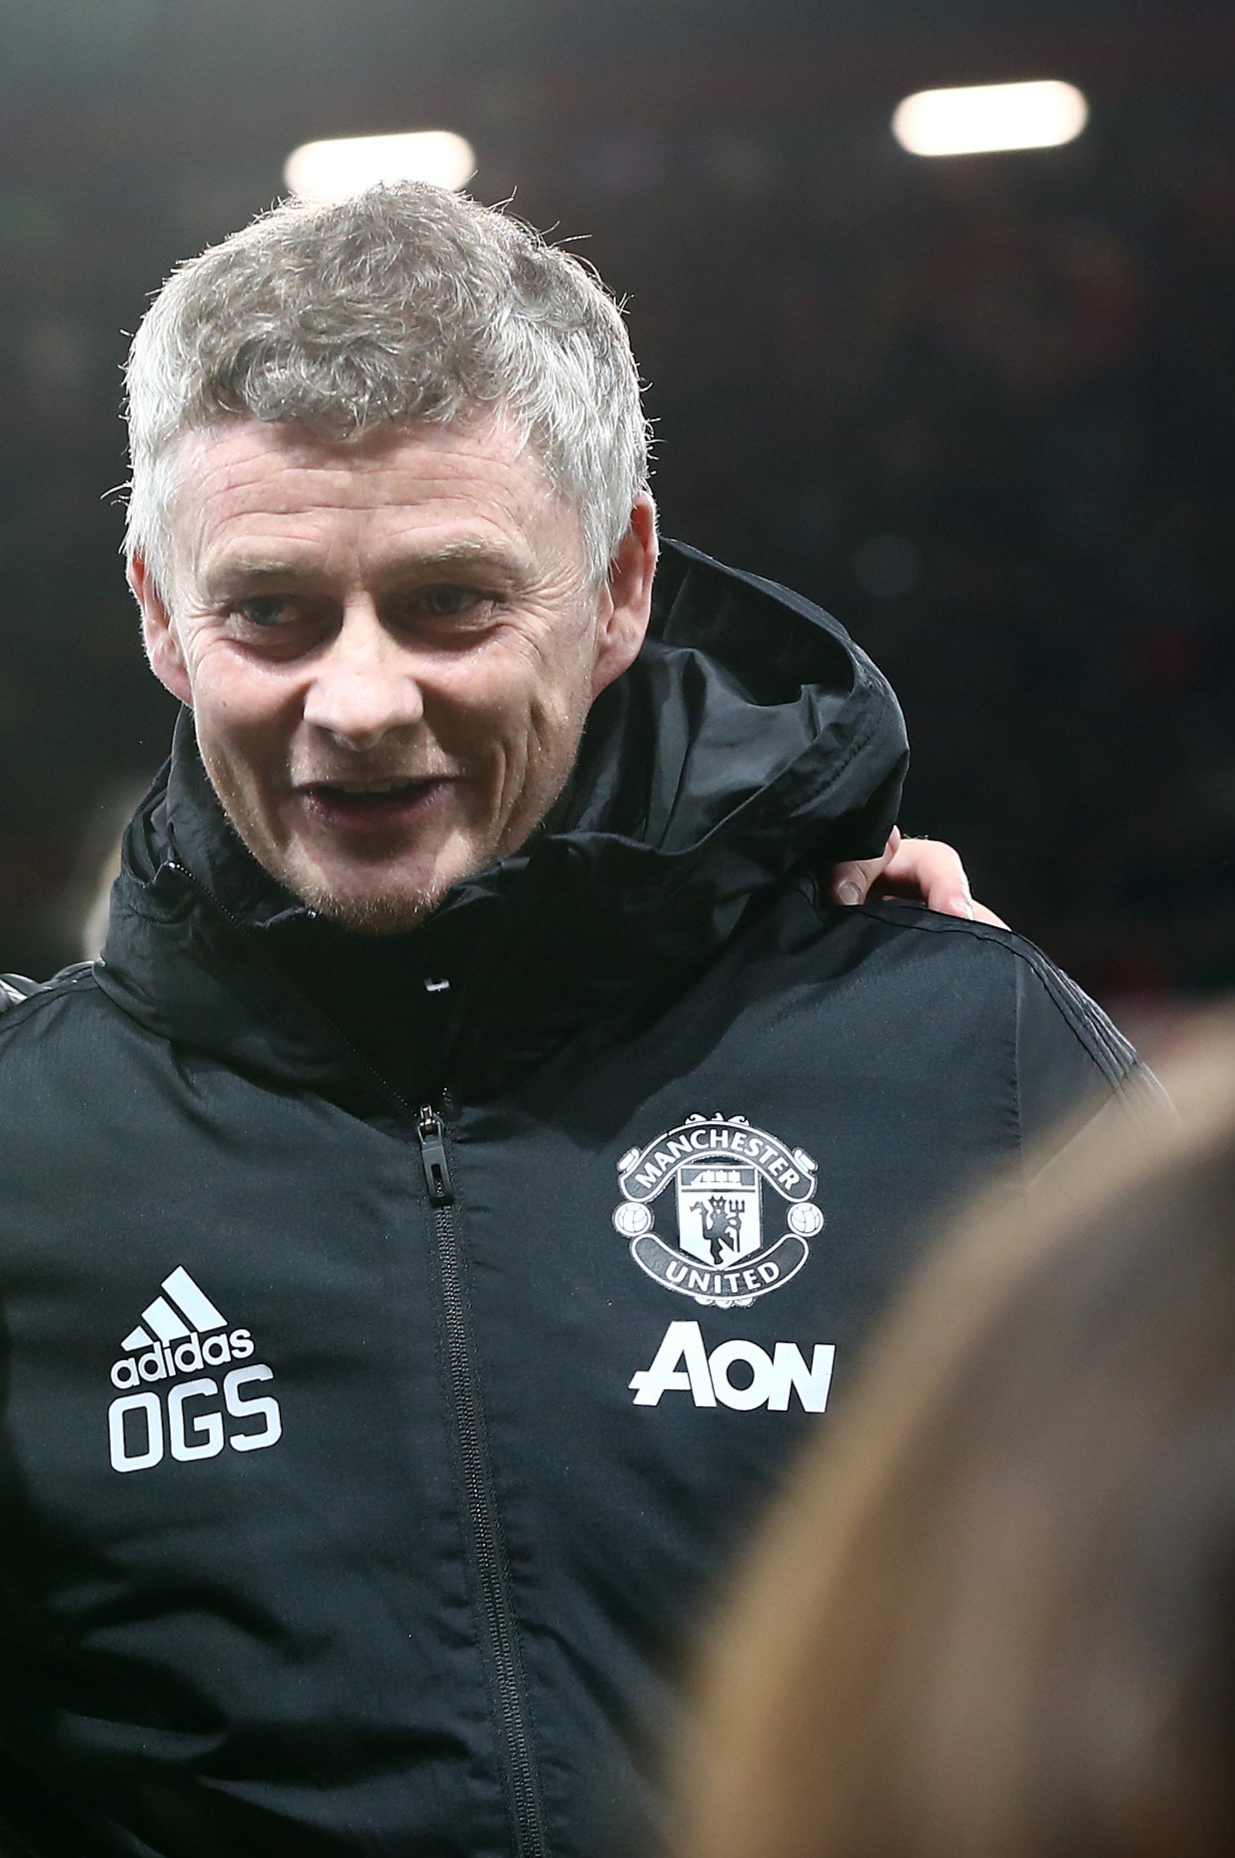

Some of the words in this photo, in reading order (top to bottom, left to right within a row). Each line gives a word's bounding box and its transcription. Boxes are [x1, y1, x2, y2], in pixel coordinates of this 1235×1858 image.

[634, 1128, 801, 1192] MANCHESTER
[665, 1260, 781, 1294] UNITED
[109, 1326, 256, 1391] adidas
[107, 1362, 283, 1474] OGS
